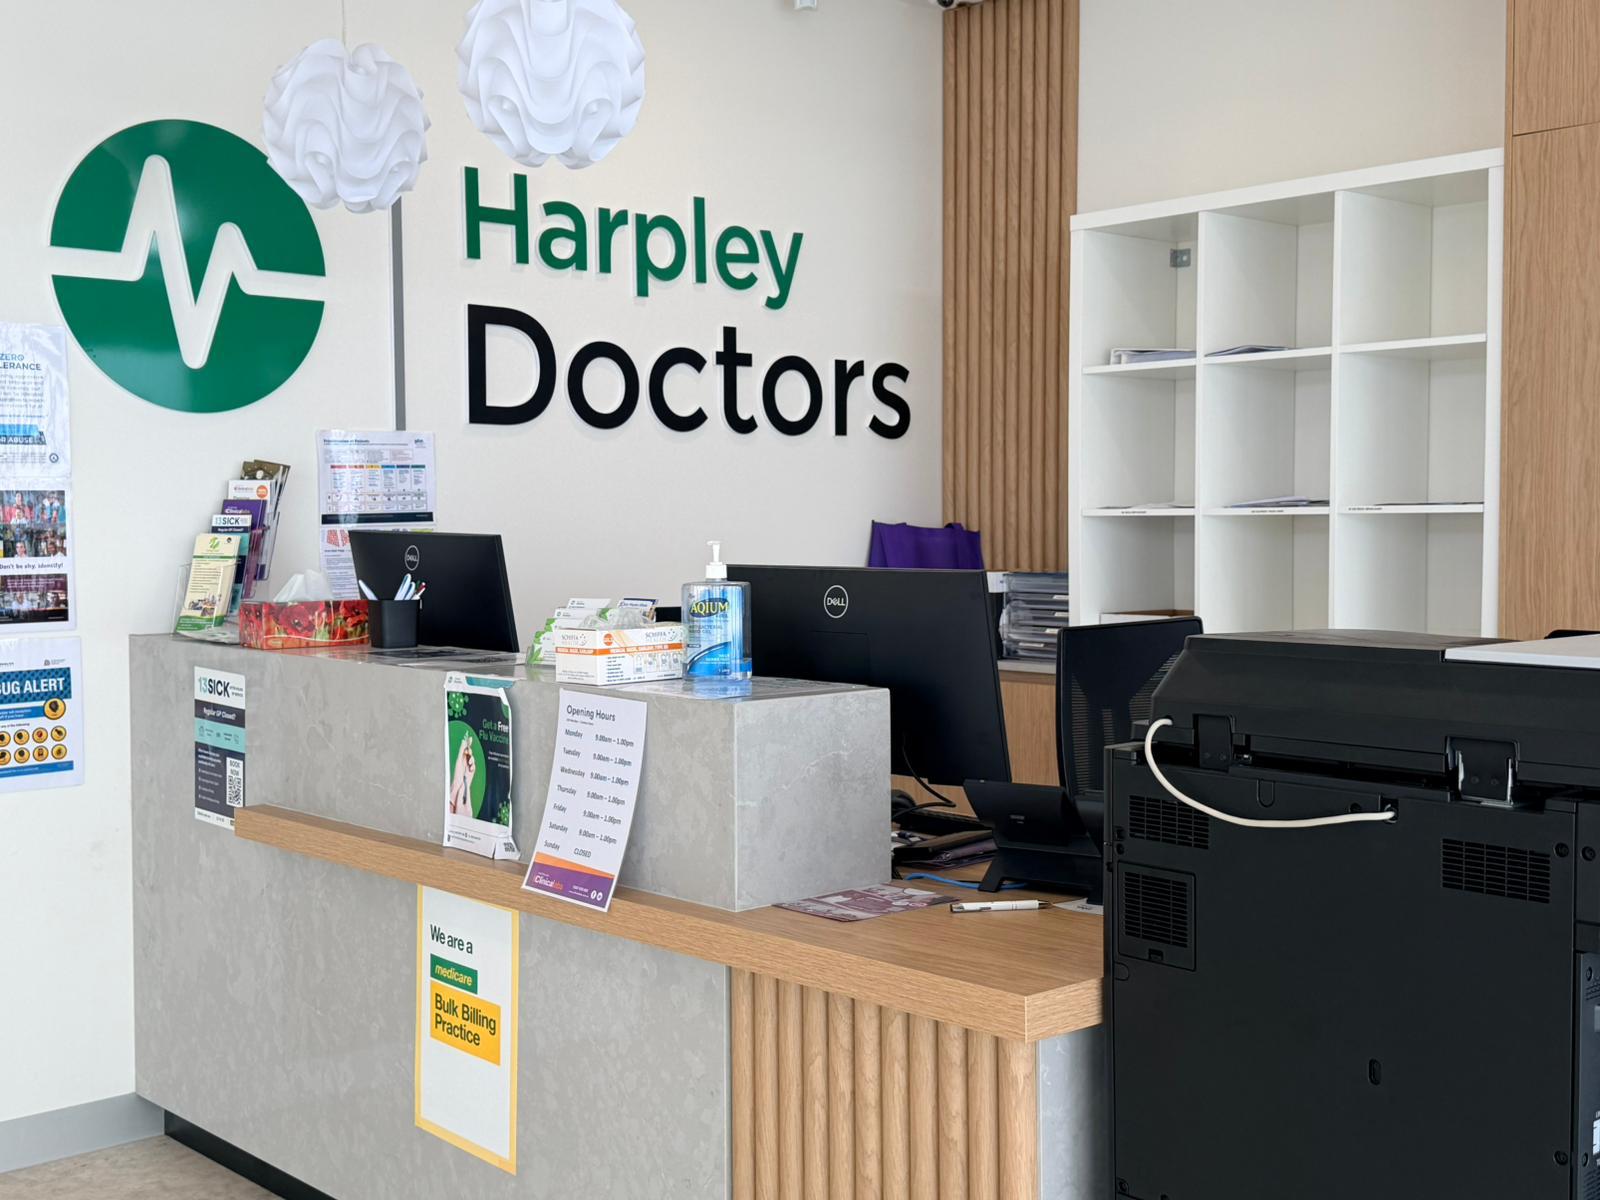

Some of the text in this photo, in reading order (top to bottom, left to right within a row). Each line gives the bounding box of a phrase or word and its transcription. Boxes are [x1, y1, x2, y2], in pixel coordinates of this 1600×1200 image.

[463, 166, 804, 310] Harpley
[466, 304, 912, 440] Doctors
[405, 554, 418, 562] DELL
[690, 601, 729, 615] AQIUM
[826, 597, 846, 606] DELL
[24, 677, 65, 694] ALERT
[199, 676, 230, 698] 13SICK
[566, 704, 595, 720] Opening
[596, 709, 616, 722] Hours
[497, 721, 509, 733] Free
[564, 729, 583, 740] Monday
[563, 747, 581, 758] Tuesday
[560, 766, 585, 777] Wednesday
[557, 784, 576, 795] Thursday
[553, 803, 567, 813] Friday
[549, 821, 568, 833] Saturday
[544, 840, 592, 858] Sunday CLOSED
[430, 924, 473, 954] We are a
[434, 964, 473, 987] medicare
[435, 992, 497, 1036] Bulk Billing
[434, 1013, 481, 1046] Practice
